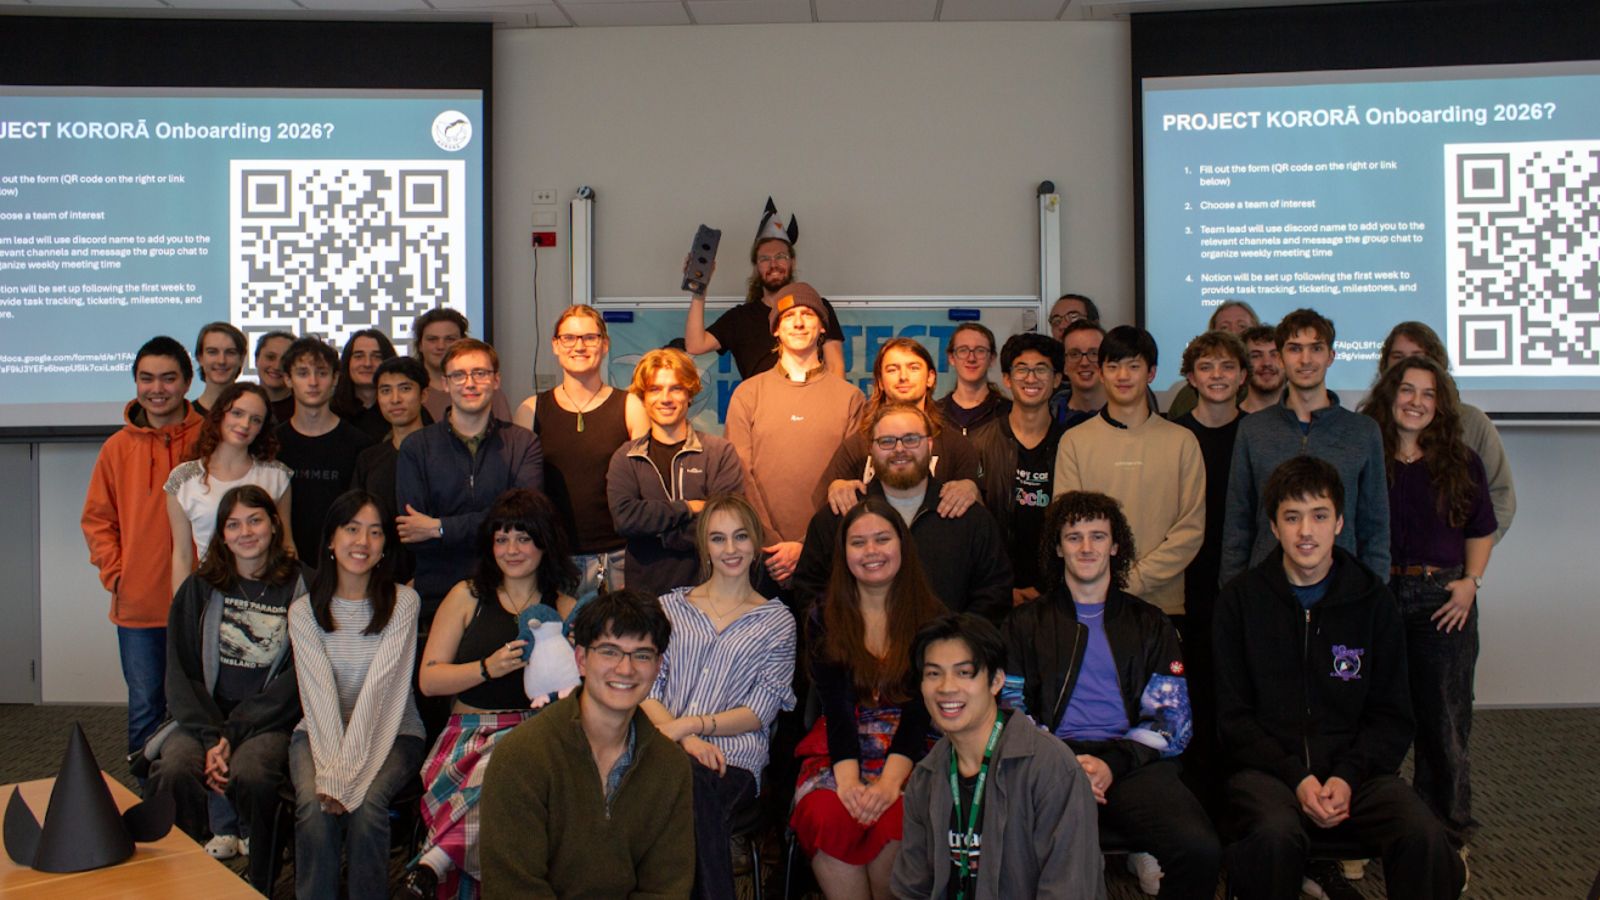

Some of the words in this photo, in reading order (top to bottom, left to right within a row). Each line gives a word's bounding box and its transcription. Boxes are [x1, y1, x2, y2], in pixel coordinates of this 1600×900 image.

[1163, 111, 1261, 131] PROJECT
[1267, 104, 1360, 128] KORORĀ
[1366, 105, 1487, 125] Onboarding
[1494, 102, 1557, 121] 2026?
[0, 120, 51, 139] JECT
[57, 119, 149, 139] KORORĀ
[155, 122, 271, 143] Onboarding
[277, 122, 335, 139] 2026?
[1200, 165, 1213, 175] Fill
[1214, 165, 1230, 174] out
[1230, 165, 1245, 174] the
[1246, 164, 1270, 173] form
[1270, 163, 1290, 175] (QR
[1290, 163, 1313, 172] code
[1328, 162, 1344, 171] the
[1346, 162, 1367, 173] right
[1380, 161, 1398, 170] link
[2, 174, 18, 183] out
[20, 174, 36, 183] the
[36, 174, 60, 183] form
[60, 174, 78, 185] (QR
[80, 174, 104, 183] code
[118, 174, 134, 183] the
[134, 174, 156, 185] right
[168, 174, 186, 183] link
[1200, 176, 1232, 188] below)
[1184, 200, 1192, 210] 2.
[1200, 200, 1235, 209] Choose
[1244, 199, 1268, 208] team
[1270, 199, 1280, 208] of
[1280, 198, 1316, 208] interest
[32, 210, 58, 220] team
[58, 210, 68, 220] of
[69, 210, 104, 219] interest
[1200, 225, 1225, 234] Team
[1226, 224, 1246, 233] lead
[1248, 224, 1264, 233] will
[1284, 223, 1318, 232] discord
[1348, 222, 1358, 231] to
[1360, 222, 1378, 231] add
[1380, 224, 1397, 233] you
[1398, 221, 1408, 230] to
[1409, 221, 1425, 230] the
[14, 235, 34, 244] lead
[36, 235, 52, 244] will
[72, 235, 108, 244] discord
[136, 234, 146, 244] to
[147, 234, 166, 243] add
[166, 237, 184, 245] you
[184, 234, 194, 243] to
[196, 234, 210, 243] the
[1200, 237, 1238, 246] relevant
[1238, 236, 1282, 246] channels
[1282, 236, 1300, 245] and
[1302, 238, 1344, 247] message
[1344, 235, 1360, 244] the
[1362, 237, 1389, 246] group
[1390, 234, 1412, 243] chat
[1412, 234, 1423, 243] to
[0, 247, 24, 256] evant
[26, 247, 70, 256] channels
[70, 247, 88, 256] and
[90, 249, 132, 258] message
[132, 246, 148, 255] the
[148, 248, 176, 257] group
[176, 246, 198, 255] chat
[198, 246, 208, 255] to
[1200, 249, 1239, 260] organize
[1240, 248, 1272, 260] weekly
[1273, 248, 1311, 259] meeting
[1312, 247, 1334, 256] time
[28, 259, 60, 271] weekly
[62, 259, 100, 270] meeting
[100, 259, 122, 268] time
[1184, 273, 1194, 282] 4.
[1200, 273, 1232, 282] Notion
[1234, 272, 1250, 281] will
[1250, 272, 1263, 281] be
[1264, 272, 1278, 281] set
[1280, 274, 1292, 283] up
[1294, 271, 1336, 282] following
[1336, 270, 1352, 280] the
[1354, 270, 1372, 279] first
[1374, 270, 1399, 279] week
[1400, 269, 1410, 279] to
[0, 284, 18, 293] tion
[20, 284, 38, 293] will
[38, 284, 50, 293] be
[52, 283, 66, 293] set
[68, 286, 80, 295] up
[82, 283, 124, 294] following
[124, 283, 140, 292] the
[140, 282, 160, 292] first
[160, 282, 184, 291] week
[186, 282, 196, 291] to
[1200, 285, 1235, 297] provide
[1236, 285, 1256, 294] task
[1258, 284, 1297, 296] tracking,
[1298, 284, 1342, 295] ticketing,
[1342, 283, 1398, 294] milestones,
[1398, 282, 1417, 292] and
[24, 296, 44, 305] task
[44, 296, 86, 307] tracking,
[86, 295, 128, 306] ticketing,
[130, 295, 184, 306] milestones,
[184, 294, 202, 303] and
